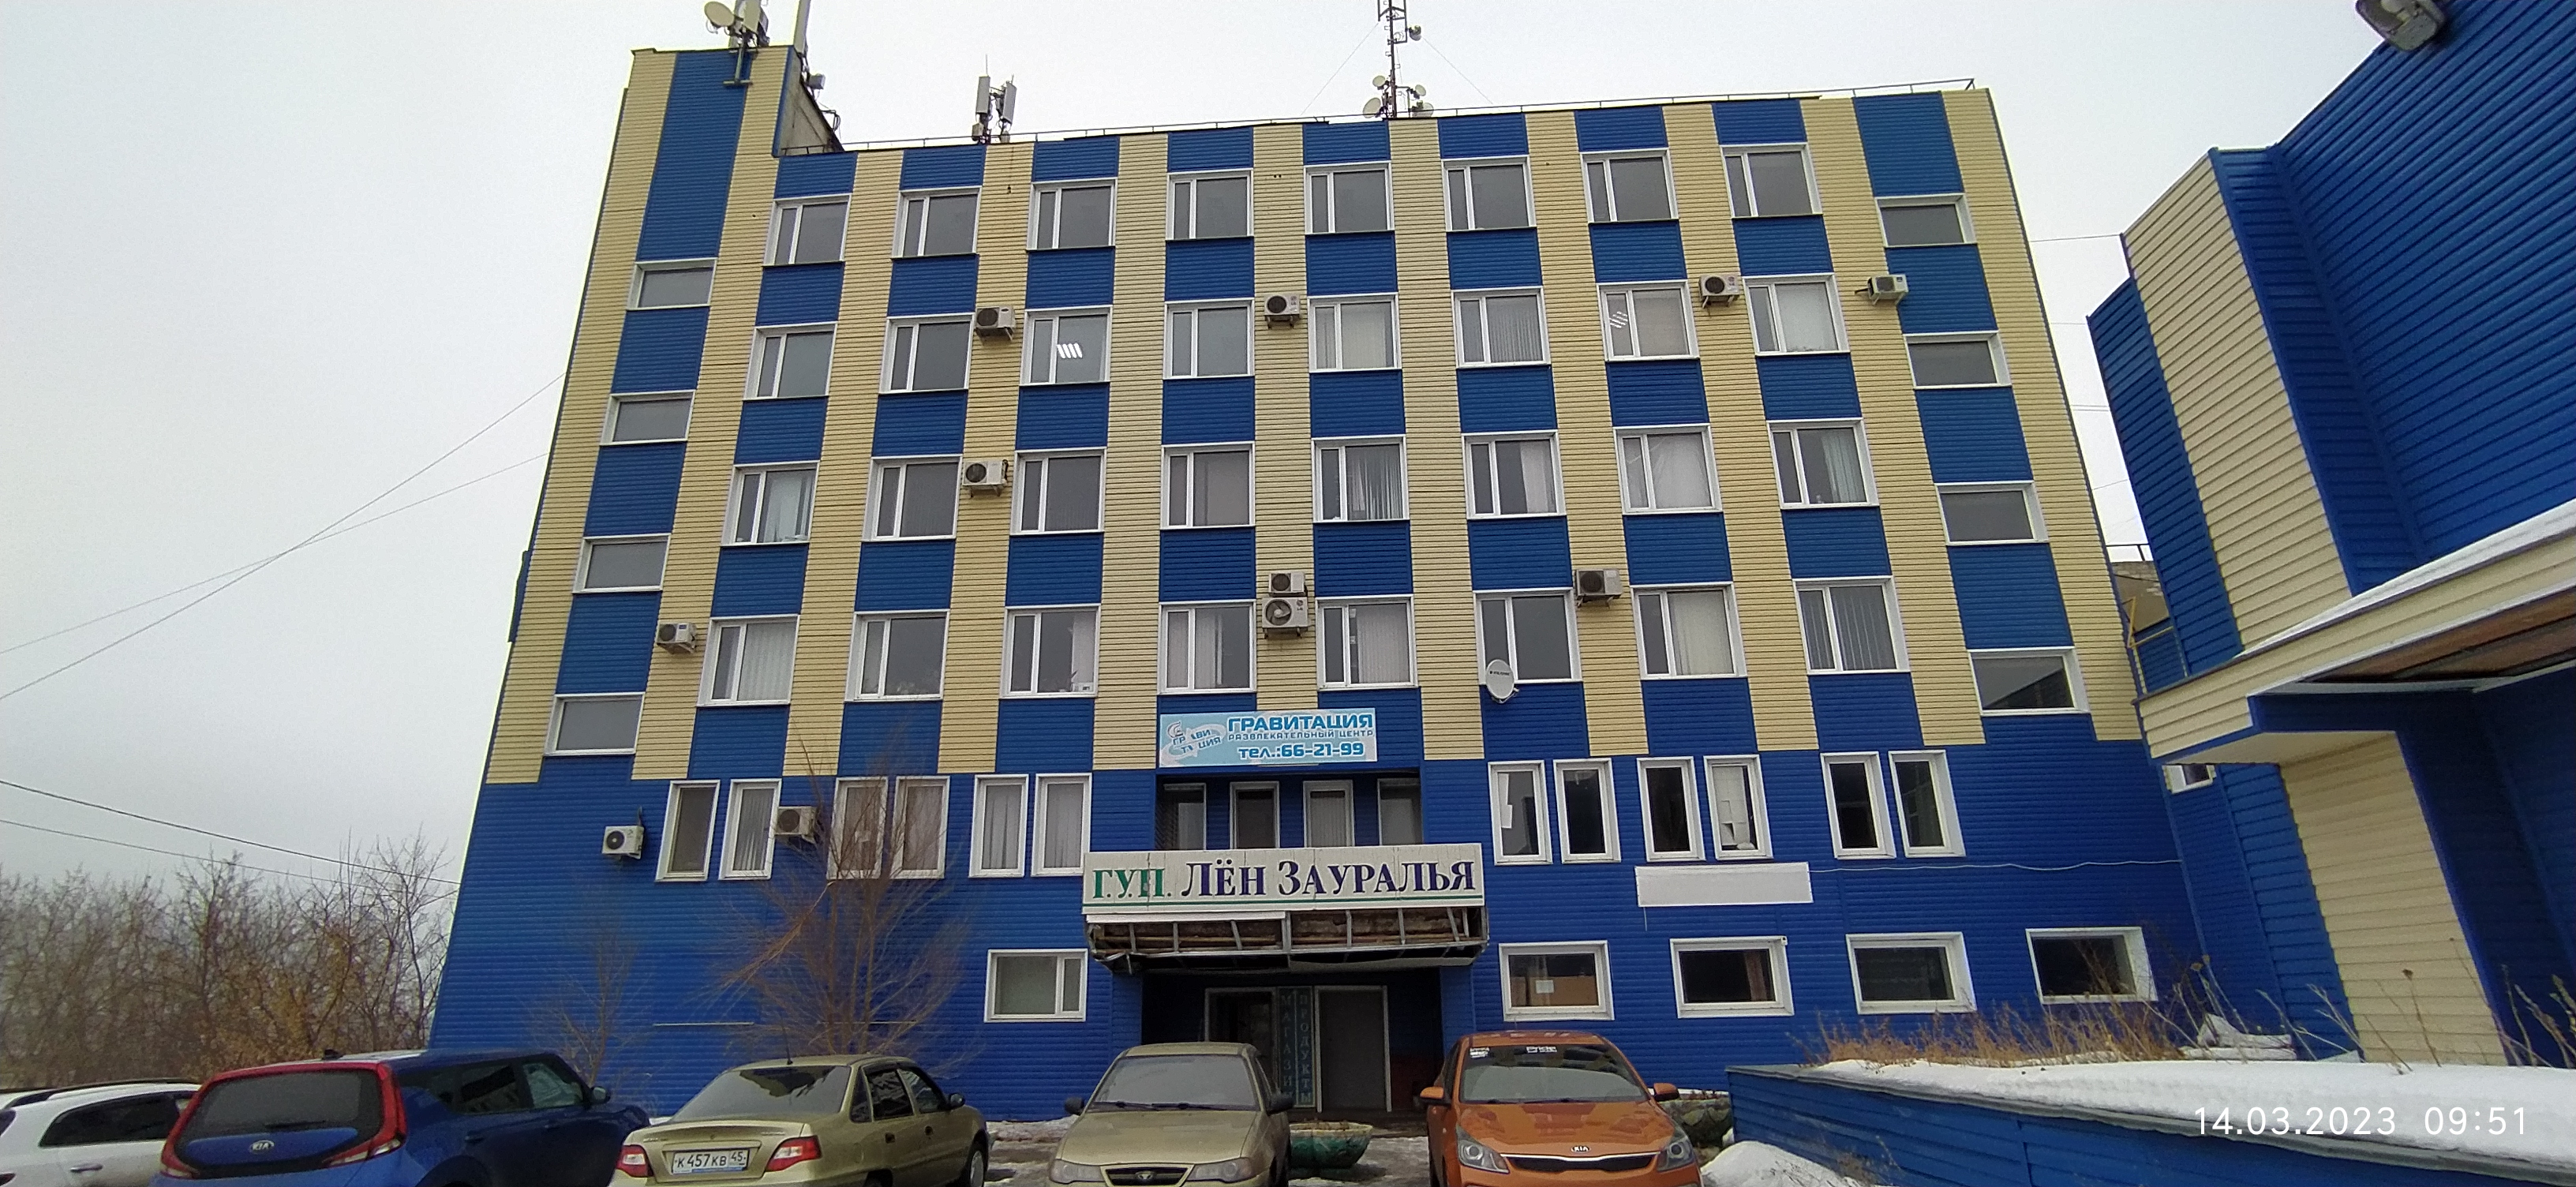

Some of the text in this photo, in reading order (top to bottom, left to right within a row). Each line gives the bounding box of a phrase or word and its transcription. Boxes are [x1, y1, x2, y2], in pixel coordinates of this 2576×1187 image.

[1228, 713, 1373, 732] ГРАВИТАЦИЯ
[1228, 729, 1373, 741] РАЗВЛЕКАТЕЛЬНЫЙ ЦЕНТР
[1181, 859, 1267, 897] ЛЁН
[1278, 860, 1475, 896] ЗАУРАЛЬЯ
[1300, 994, 1311, 1103] ПРОДУКТЫ
